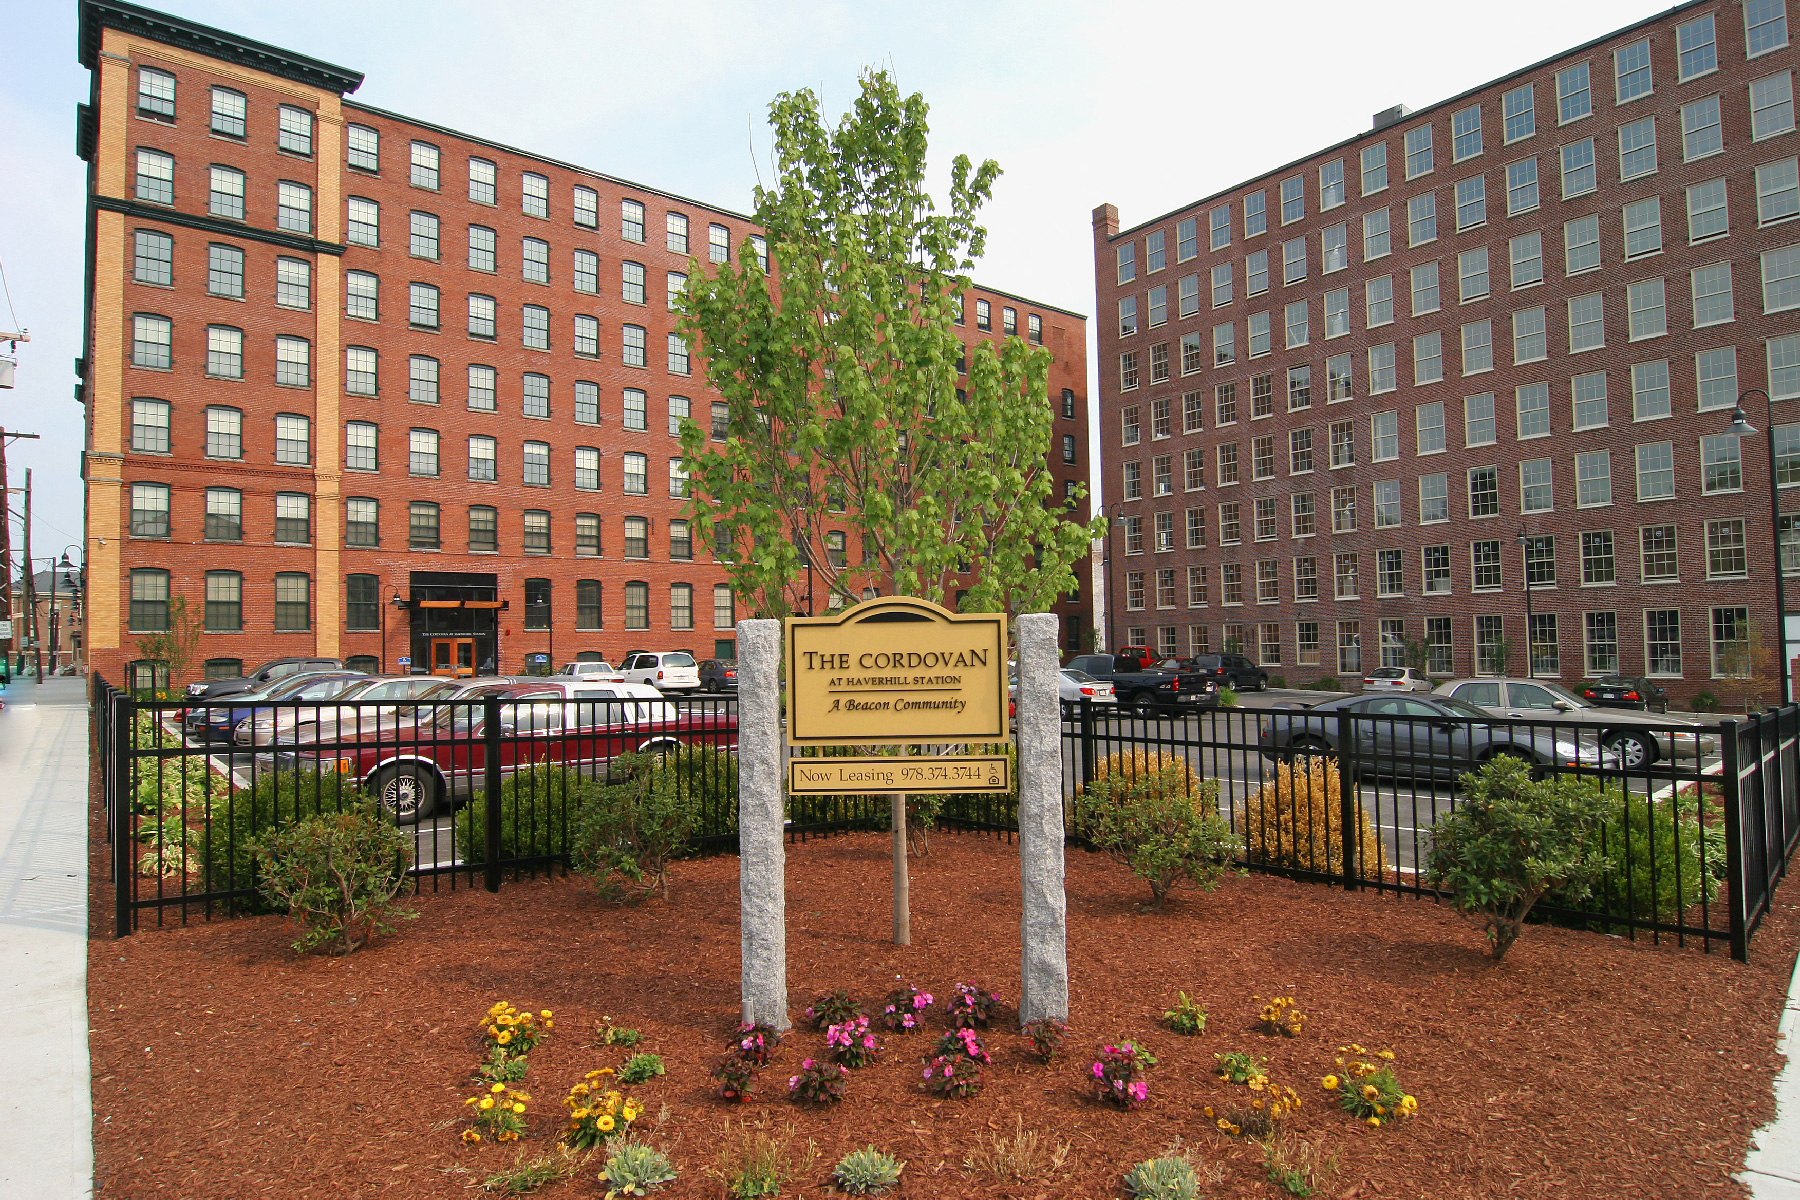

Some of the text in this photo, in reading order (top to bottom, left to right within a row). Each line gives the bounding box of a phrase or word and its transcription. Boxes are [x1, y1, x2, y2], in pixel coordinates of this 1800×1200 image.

[803, 649, 988, 670] THE CORDOVAN
[829, 675, 962, 686] AT HAVERHILL STATION
[828, 697, 967, 714] A Beacon Community
[800, 766, 982, 785] Now Leasing 978.374.3744
